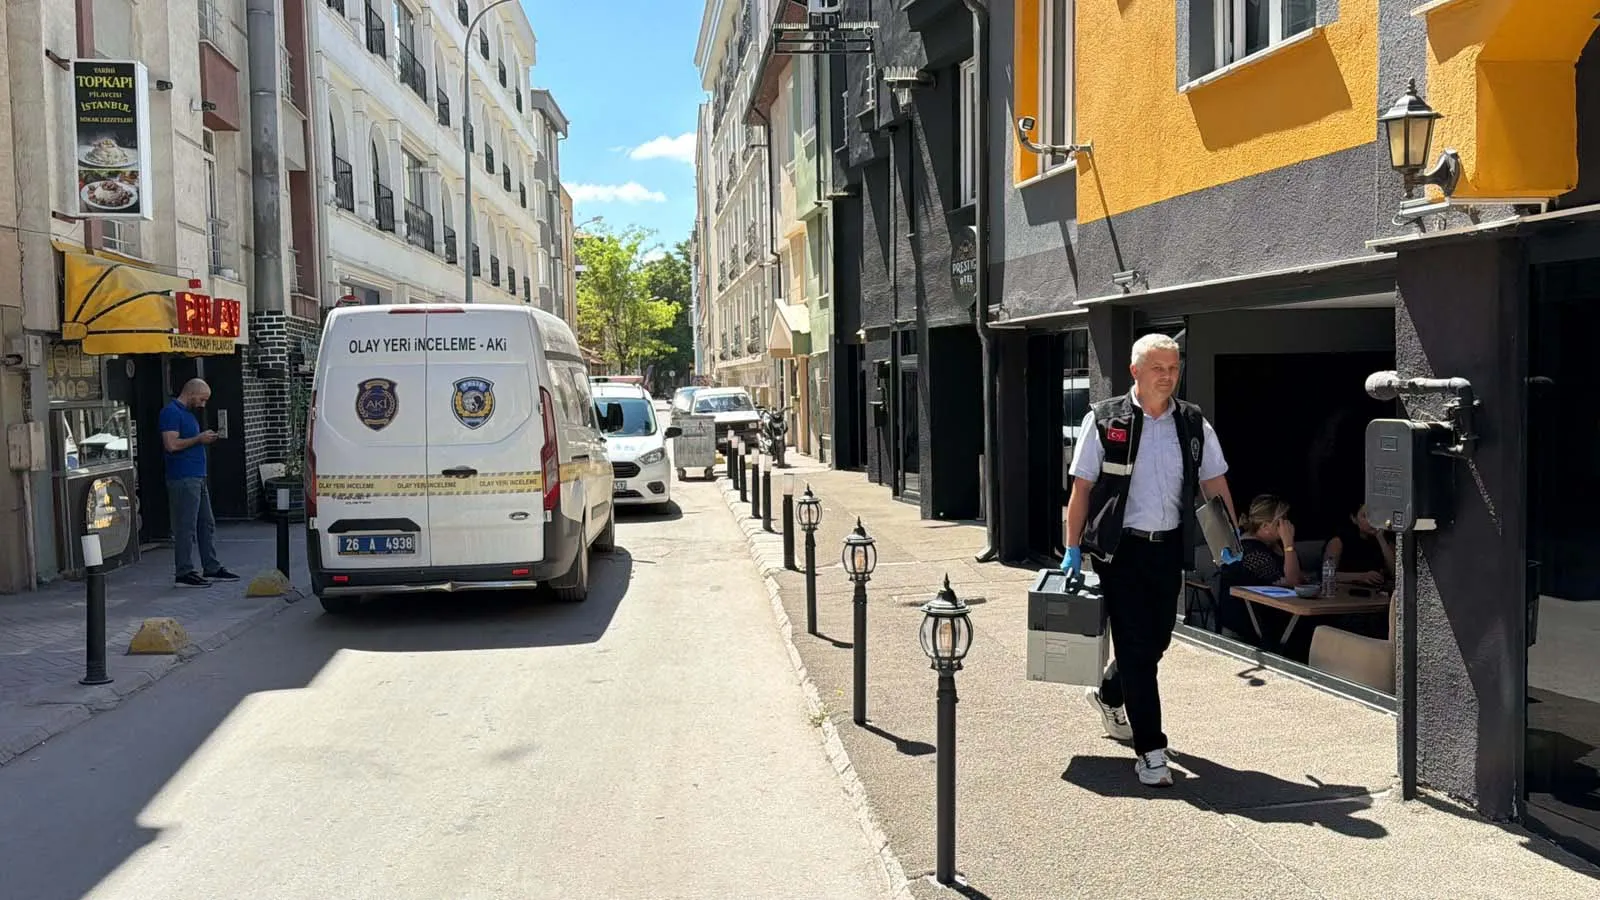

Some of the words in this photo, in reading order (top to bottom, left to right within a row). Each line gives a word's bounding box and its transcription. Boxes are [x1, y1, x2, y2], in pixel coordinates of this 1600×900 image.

[76, 75, 133, 88] TOPKAPI
[80, 101, 131, 113] İSTANBUL
[349, 339, 380, 354] OLAY
[346, 539, 360, 551] 26
[369, 538, 376, 550] A
[385, 537, 413, 549] 4938
